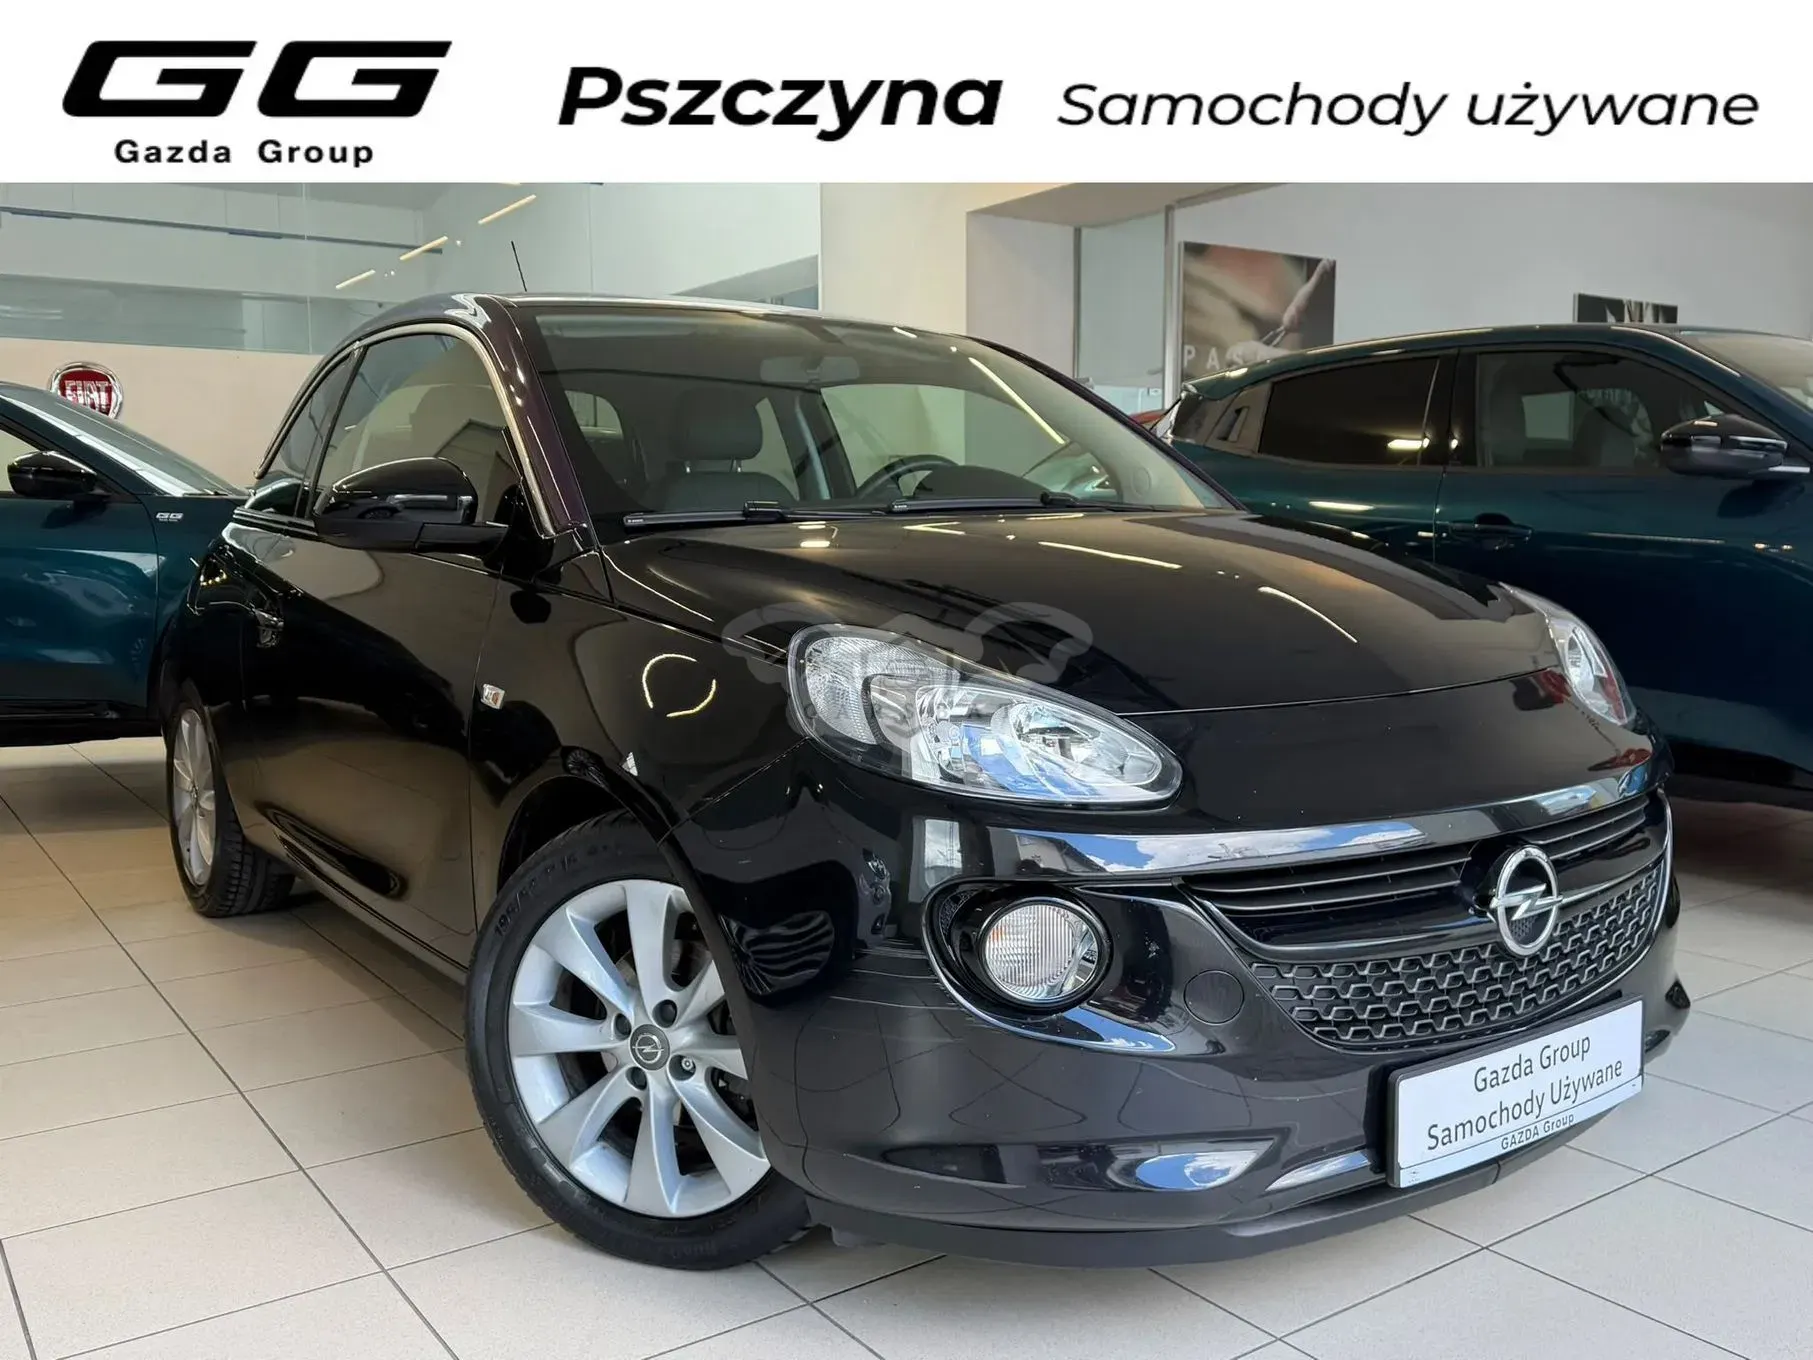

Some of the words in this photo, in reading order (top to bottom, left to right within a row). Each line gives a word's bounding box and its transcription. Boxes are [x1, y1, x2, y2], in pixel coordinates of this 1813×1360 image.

[65, 380, 109, 411] FIAT
[1473, 1053, 1534, 1093] Gazda
[1539, 1035, 1591, 1067] Group
[1427, 1090, 1546, 1151] Samochody
[1550, 1059, 1623, 1105] Używane
[1501, 1127, 1540, 1150] GAZDA
[1543, 1113, 1575, 1133] Group
